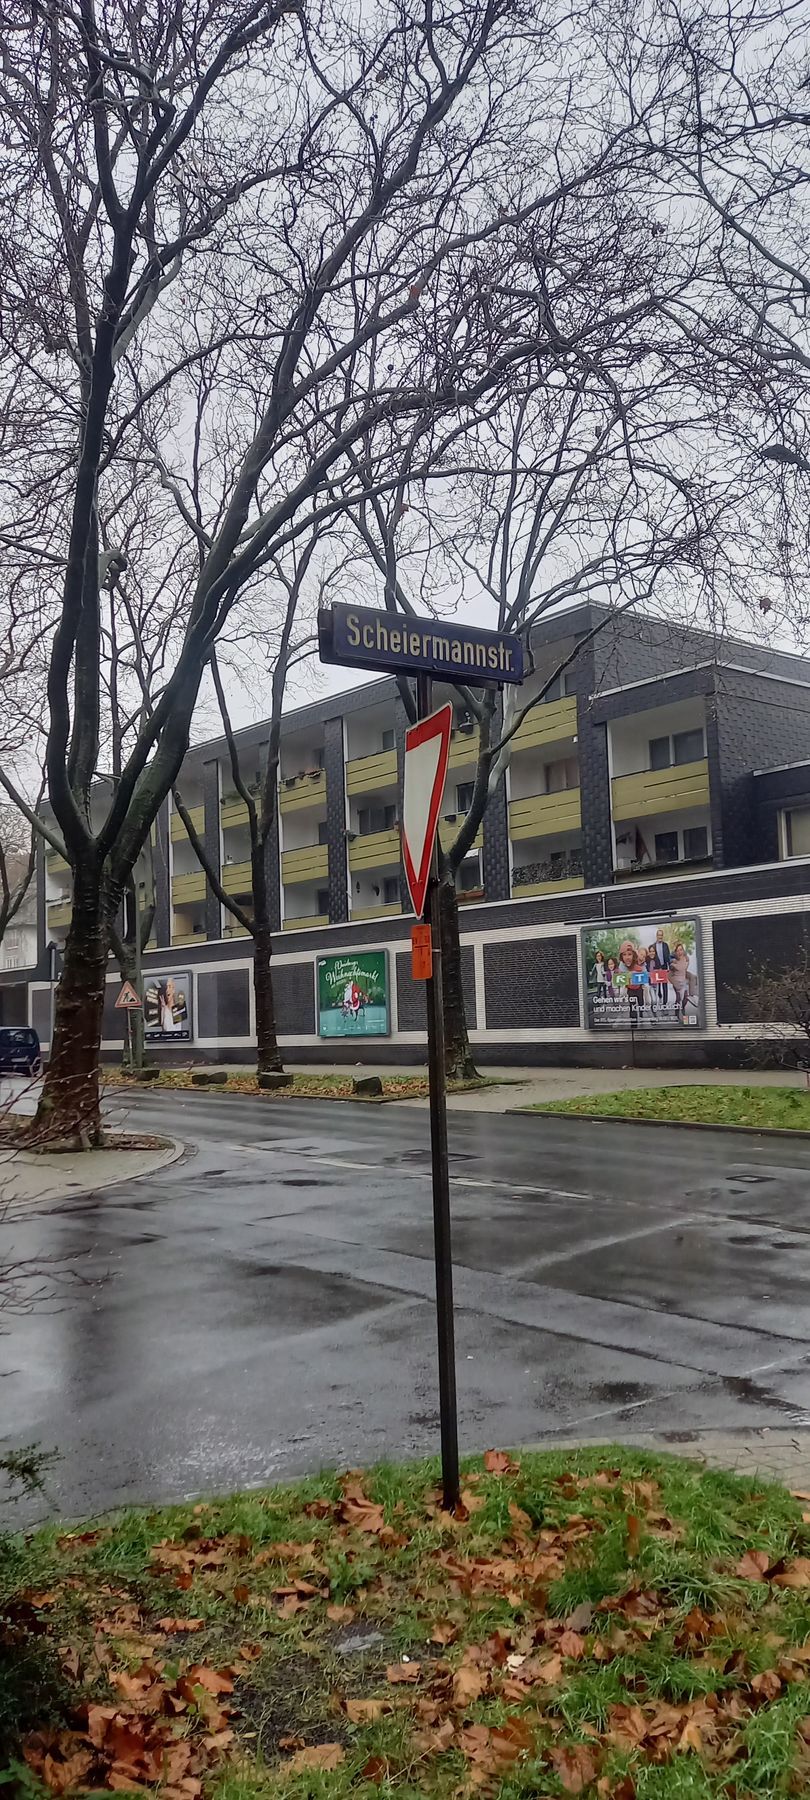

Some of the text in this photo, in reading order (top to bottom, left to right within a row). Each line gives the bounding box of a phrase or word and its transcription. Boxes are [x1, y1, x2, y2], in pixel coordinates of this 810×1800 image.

[346, 613, 515, 671] Scheiermannstr.
[616, 973, 664, 983] RTL
[592, 996, 614, 1004] Gehen
[593, 1005, 605, 1013] und
[631, 1003, 652, 1012] Kinder
